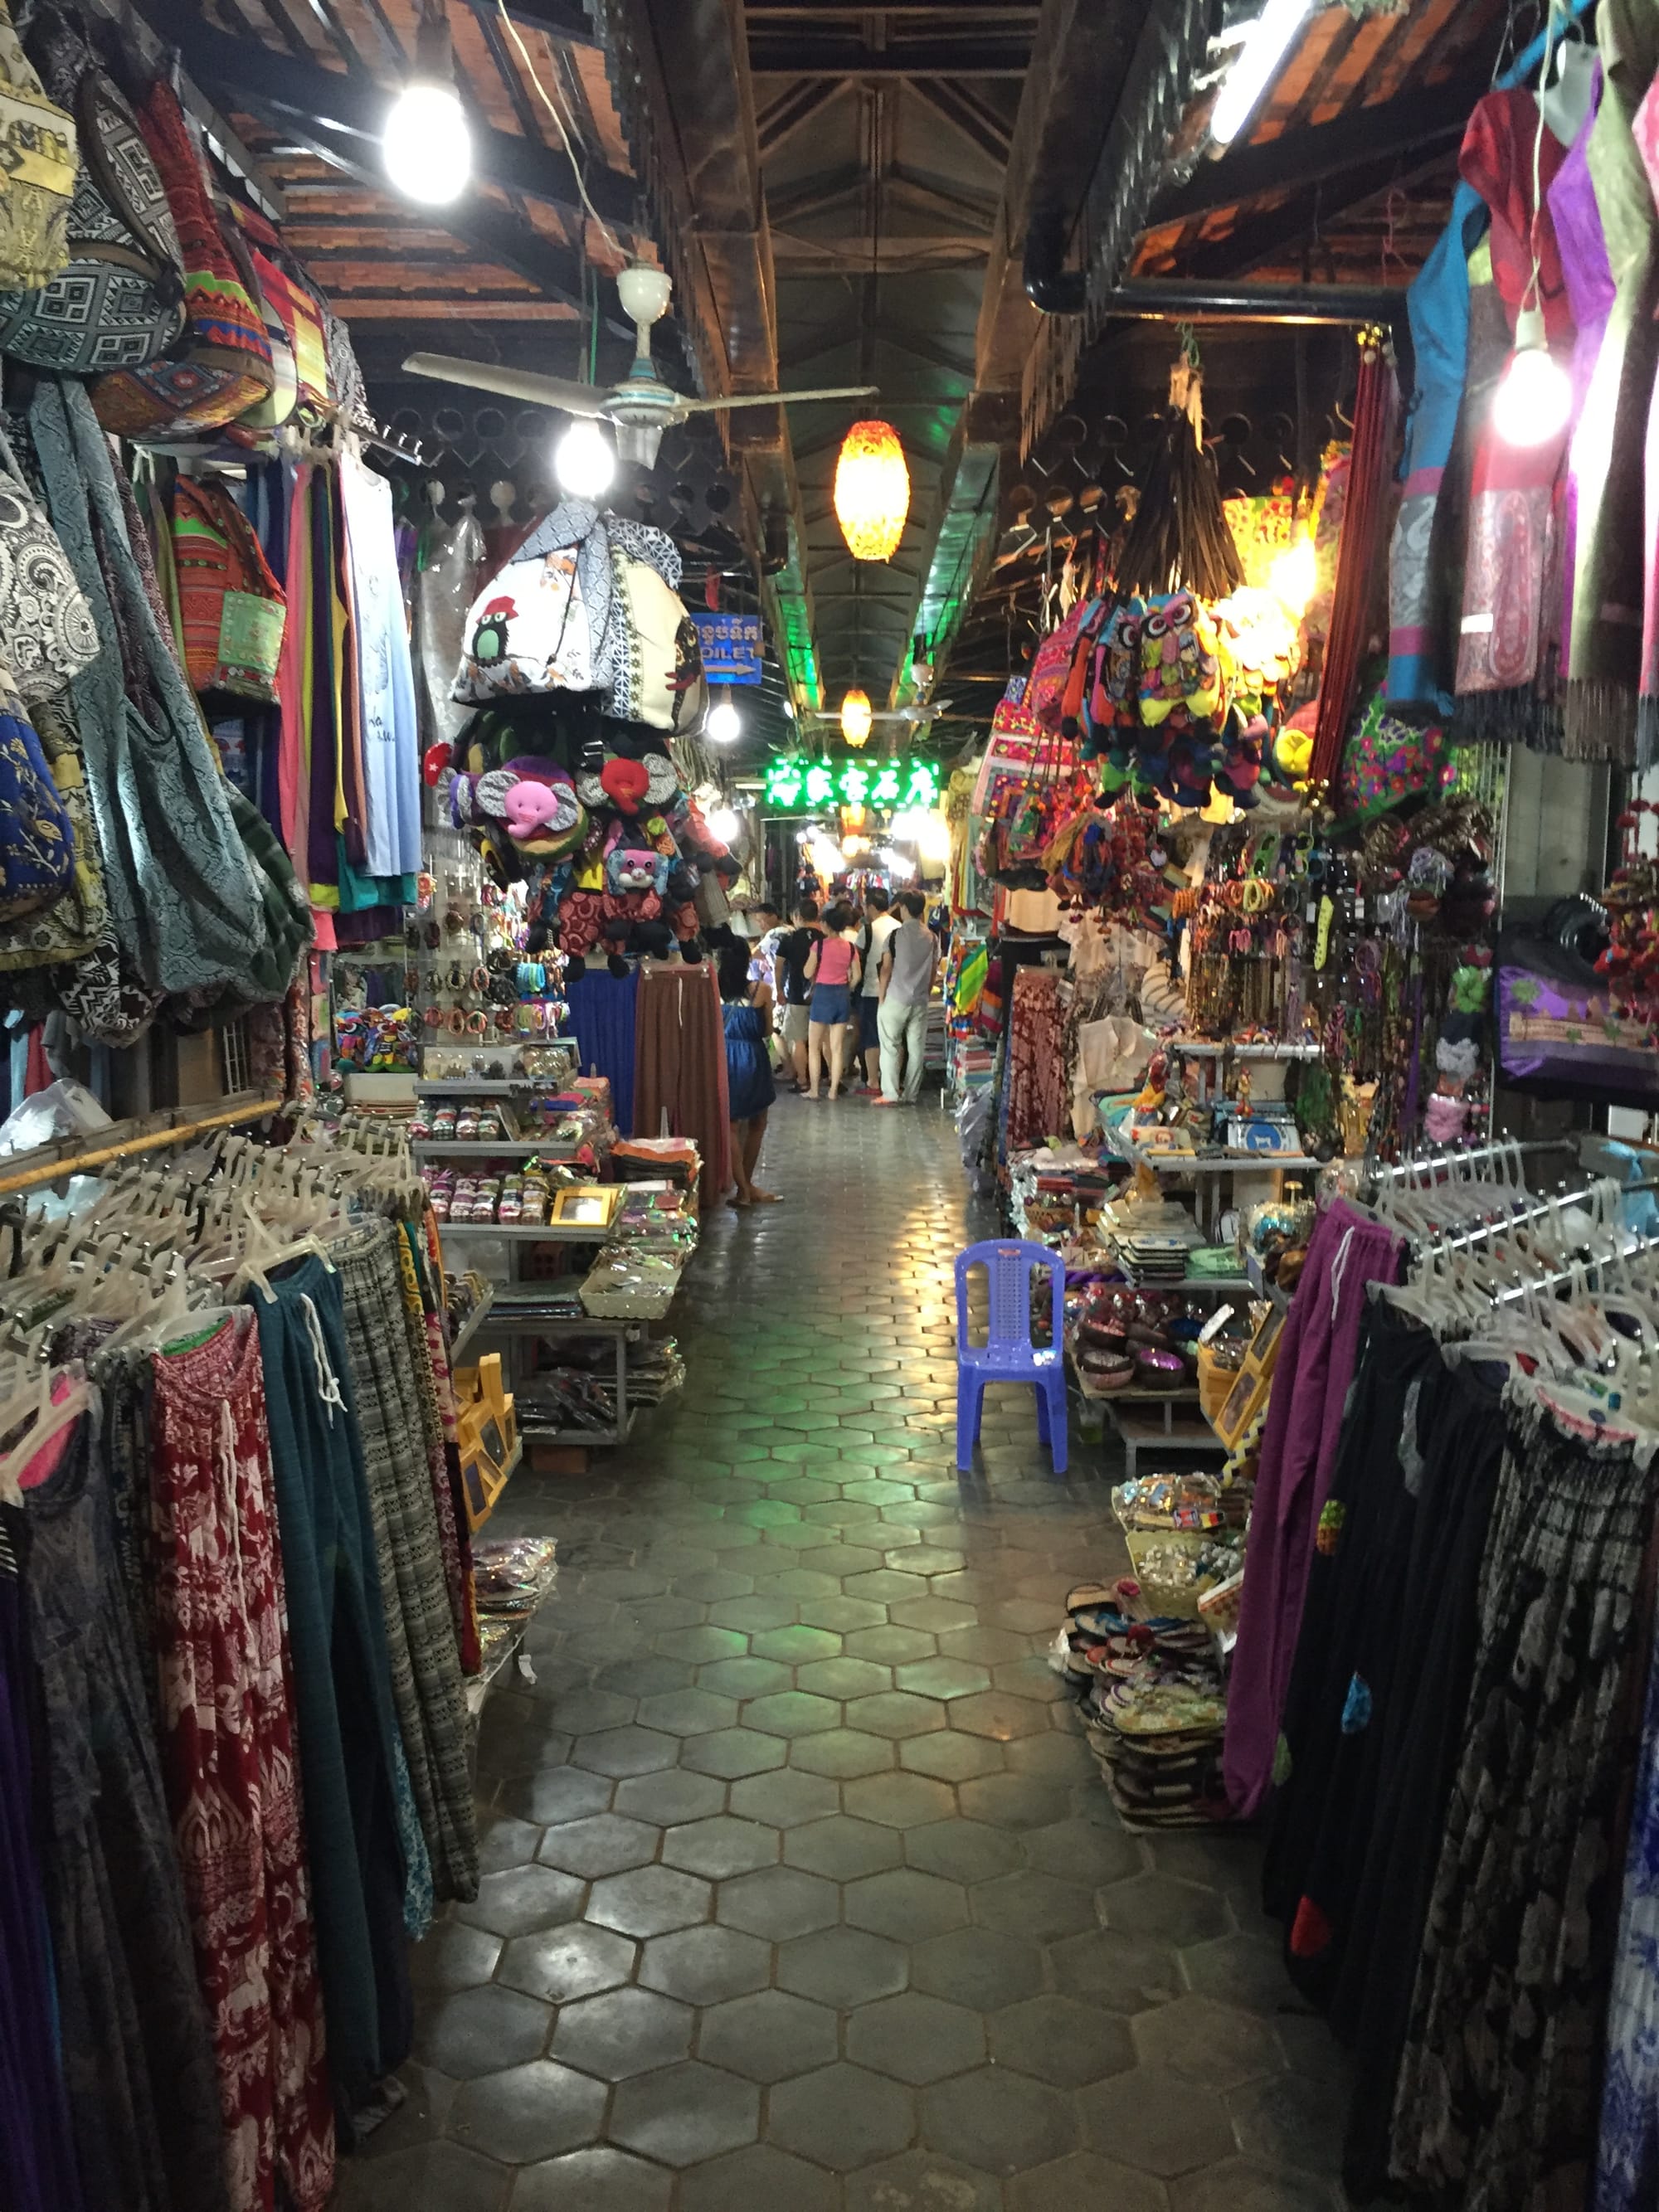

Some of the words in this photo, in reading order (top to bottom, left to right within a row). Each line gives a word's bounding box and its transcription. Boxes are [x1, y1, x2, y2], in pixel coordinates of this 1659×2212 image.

[698, 618, 758, 645] ន្ទប់ទឹក
[701, 647, 755, 660] OILET
